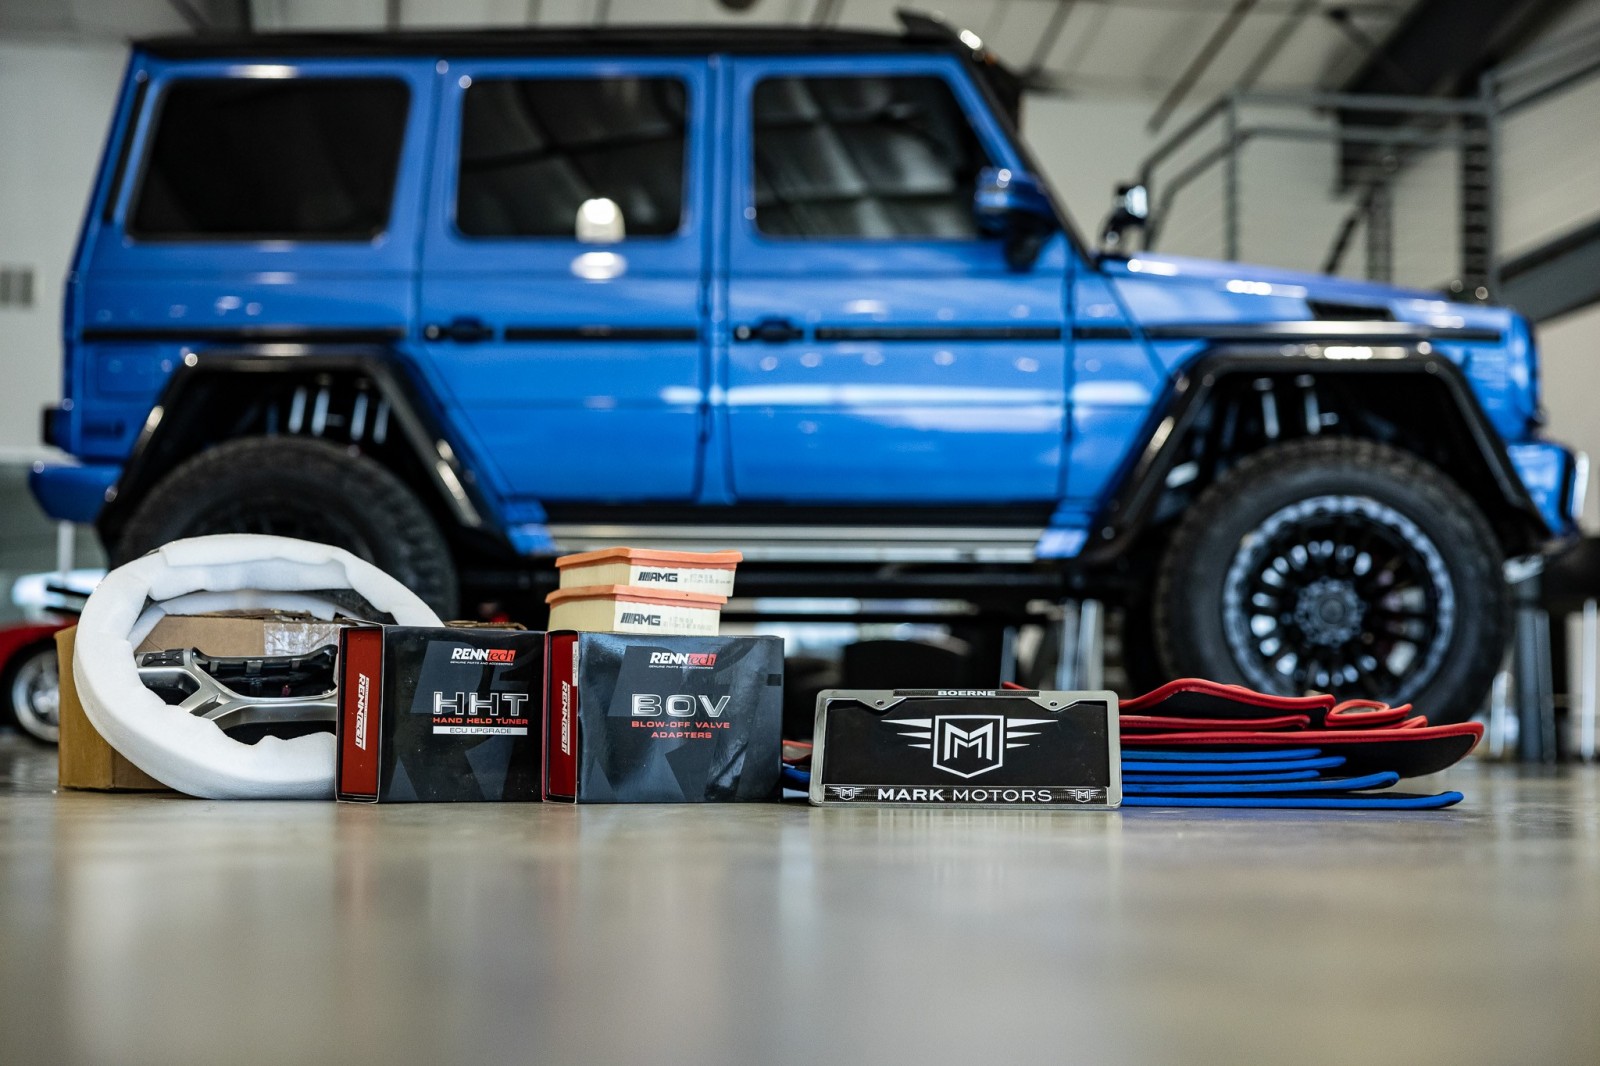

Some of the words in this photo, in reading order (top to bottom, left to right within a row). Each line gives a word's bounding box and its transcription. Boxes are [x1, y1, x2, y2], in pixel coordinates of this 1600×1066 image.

[649, 572, 678, 582] AMG
[633, 614, 661, 626] AMG
[433, 691, 529, 717] HHT
[631, 694, 731, 718] BOV
[631, 721, 691, 729] BLOW-OFF
[651, 731, 712, 739] ADAPTERS
[877, 788, 945, 801] MARK
[952, 789, 1053, 802] MOTORS
